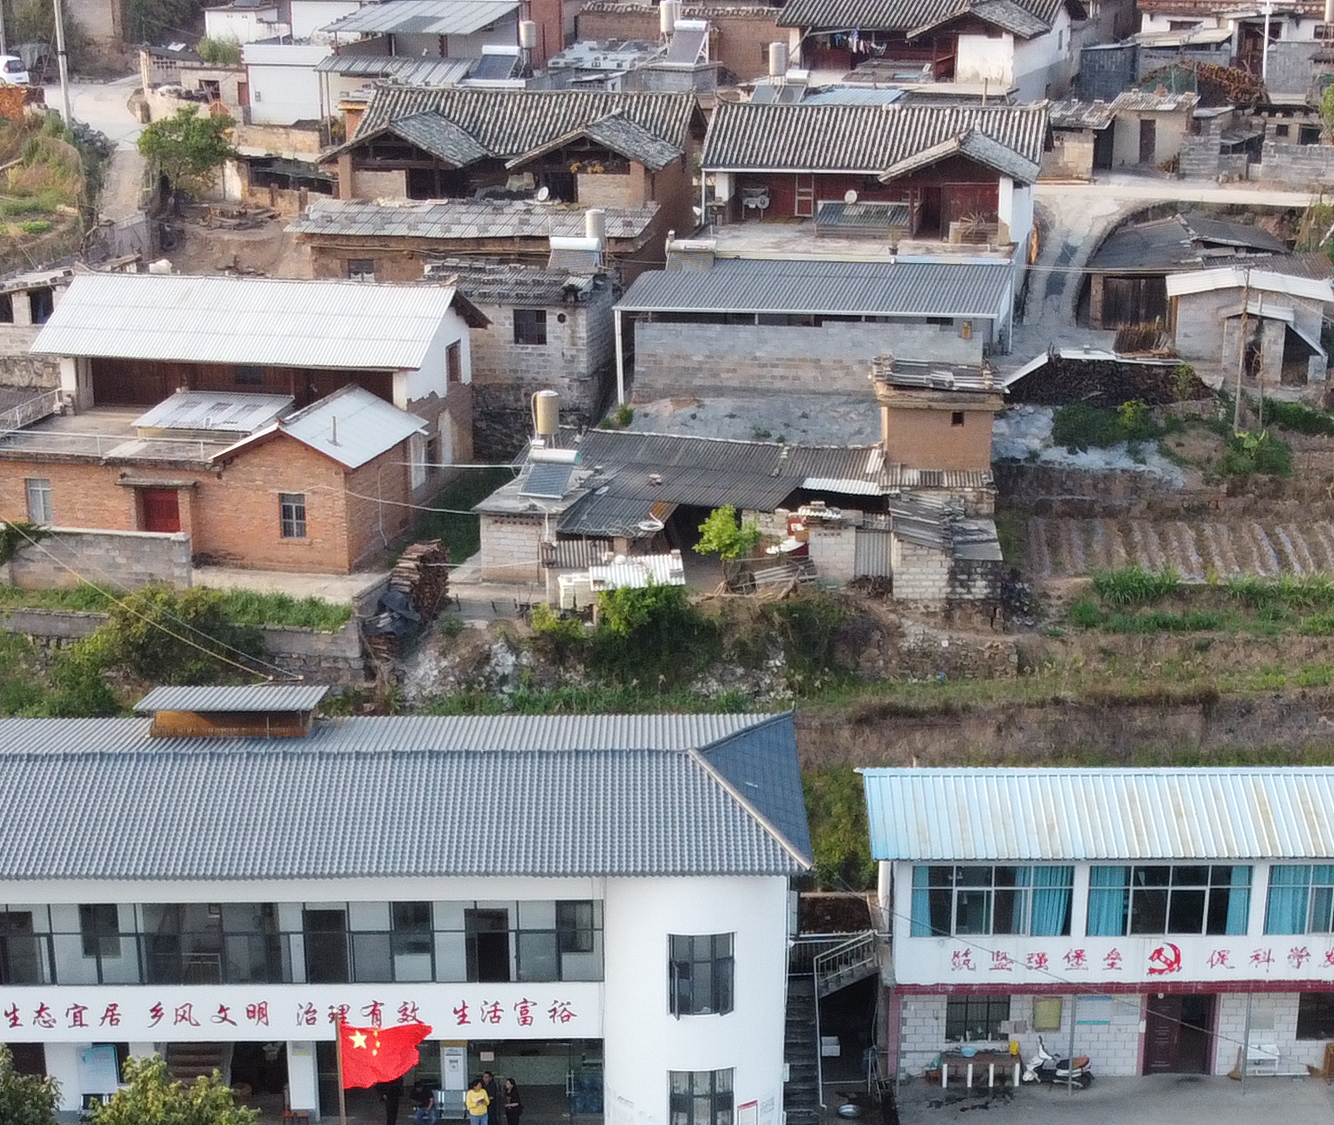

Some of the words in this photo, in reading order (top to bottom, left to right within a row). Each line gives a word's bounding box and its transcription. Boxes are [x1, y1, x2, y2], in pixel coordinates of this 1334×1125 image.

[2, 1001, 123, 1029] 生态宜居
[146, 1001, 271, 1029] 乡风文明
[295, 1000, 425, 1027] 治理有效
[451, 998, 579, 1028] 生活富裕
